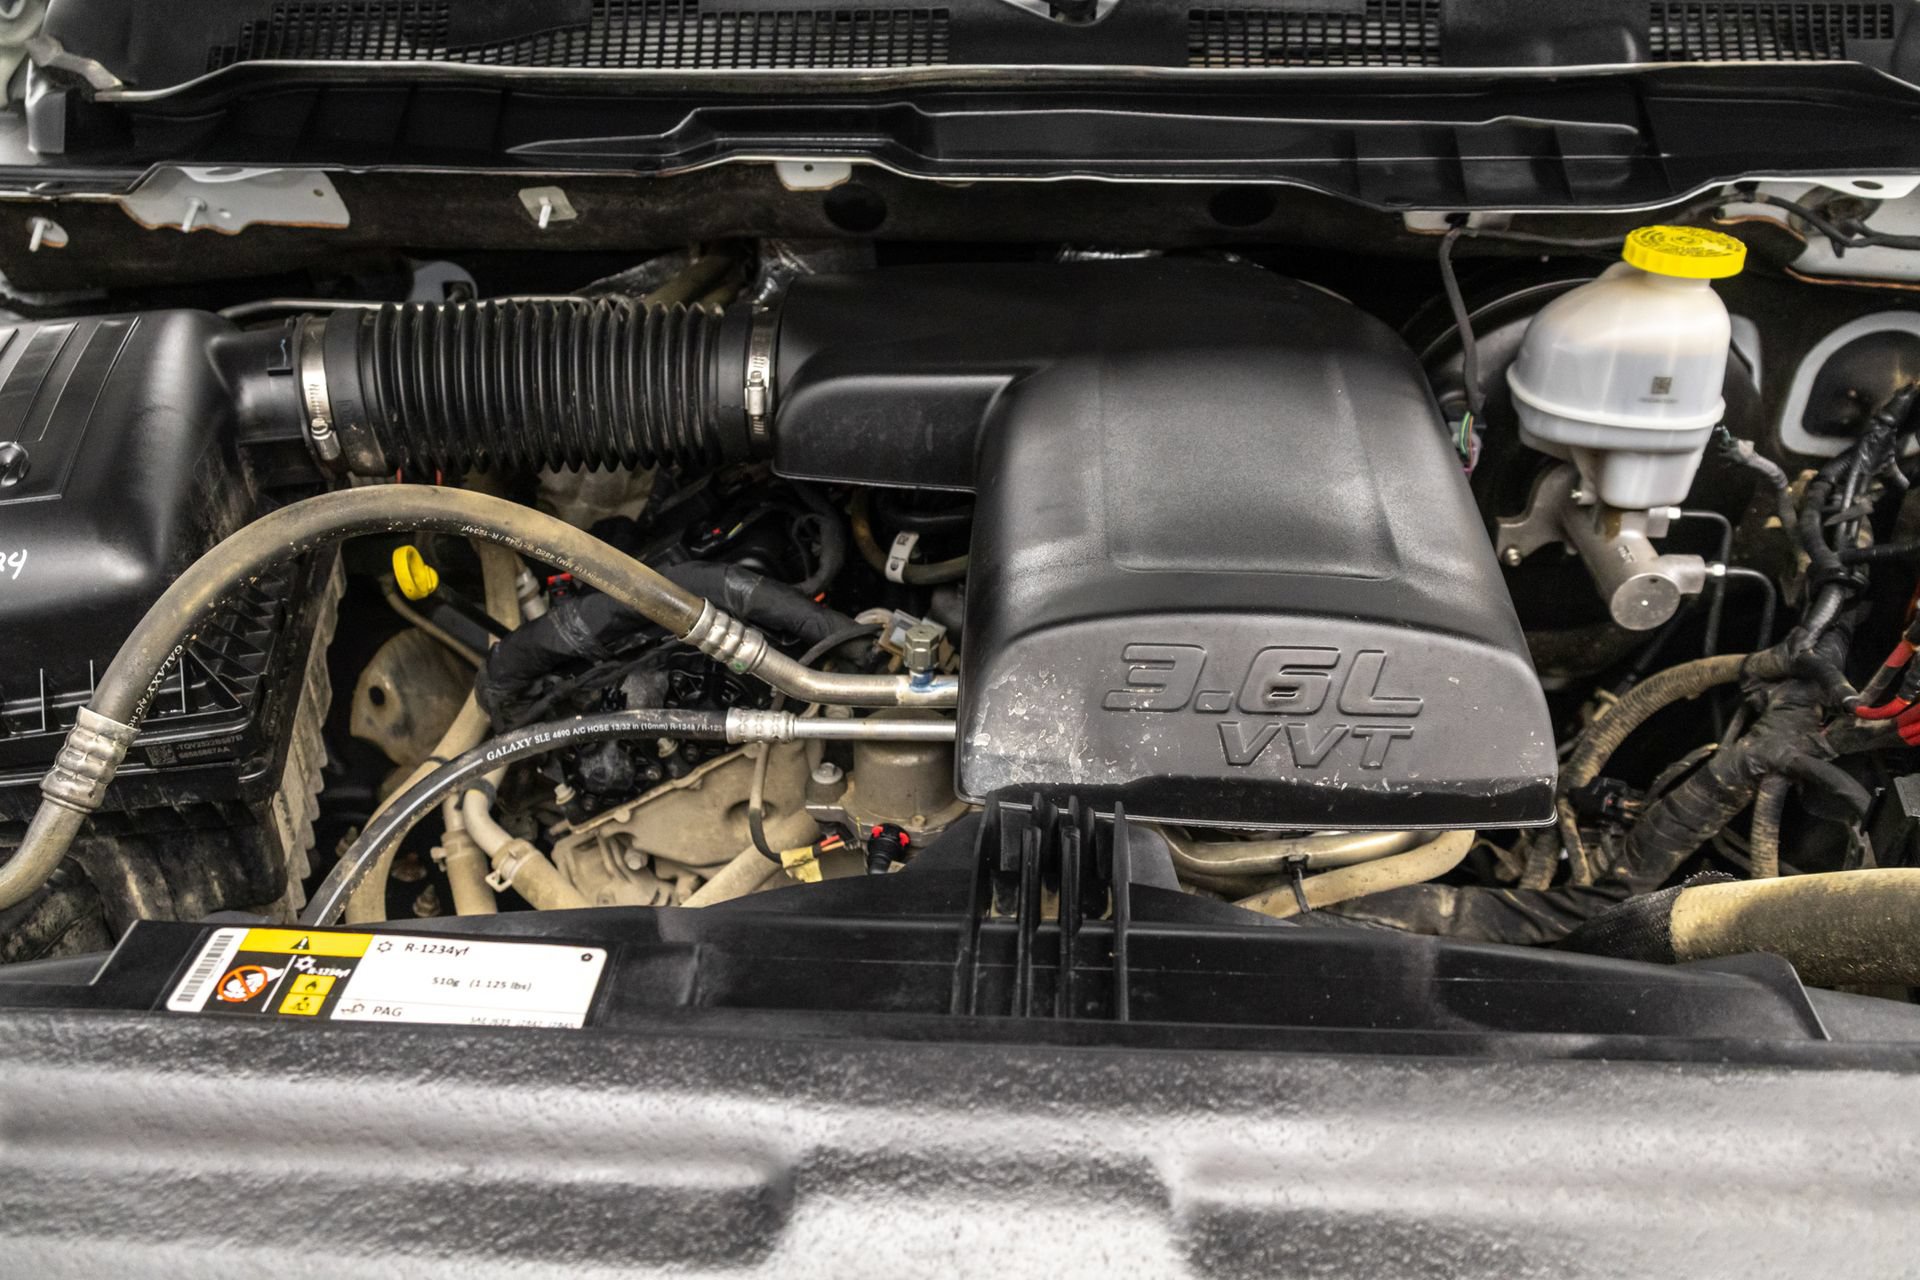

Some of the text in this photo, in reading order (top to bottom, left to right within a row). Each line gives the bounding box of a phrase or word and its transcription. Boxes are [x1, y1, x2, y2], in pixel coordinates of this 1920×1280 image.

[147, 644, 183, 698] GALAXY
[1101, 641, 1425, 718] 3.6L
[486, 736, 534, 761] GALAXY
[534, 731, 552, 744] SLE
[572, 726, 587, 736] A/C
[587, 723, 610, 734] HOSE
[611, 722, 632, 732] 13/32
[640, 722, 669, 732] (10mm)
[669, 722, 696, 732] R-134a
[1216, 720, 1416, 770] VVT
[404, 942, 470, 957] R-1234yf
[431, 976, 461, 988] 510g
[510, 981, 532, 992] lbs)
[372, 1005, 403, 1018] PAG
